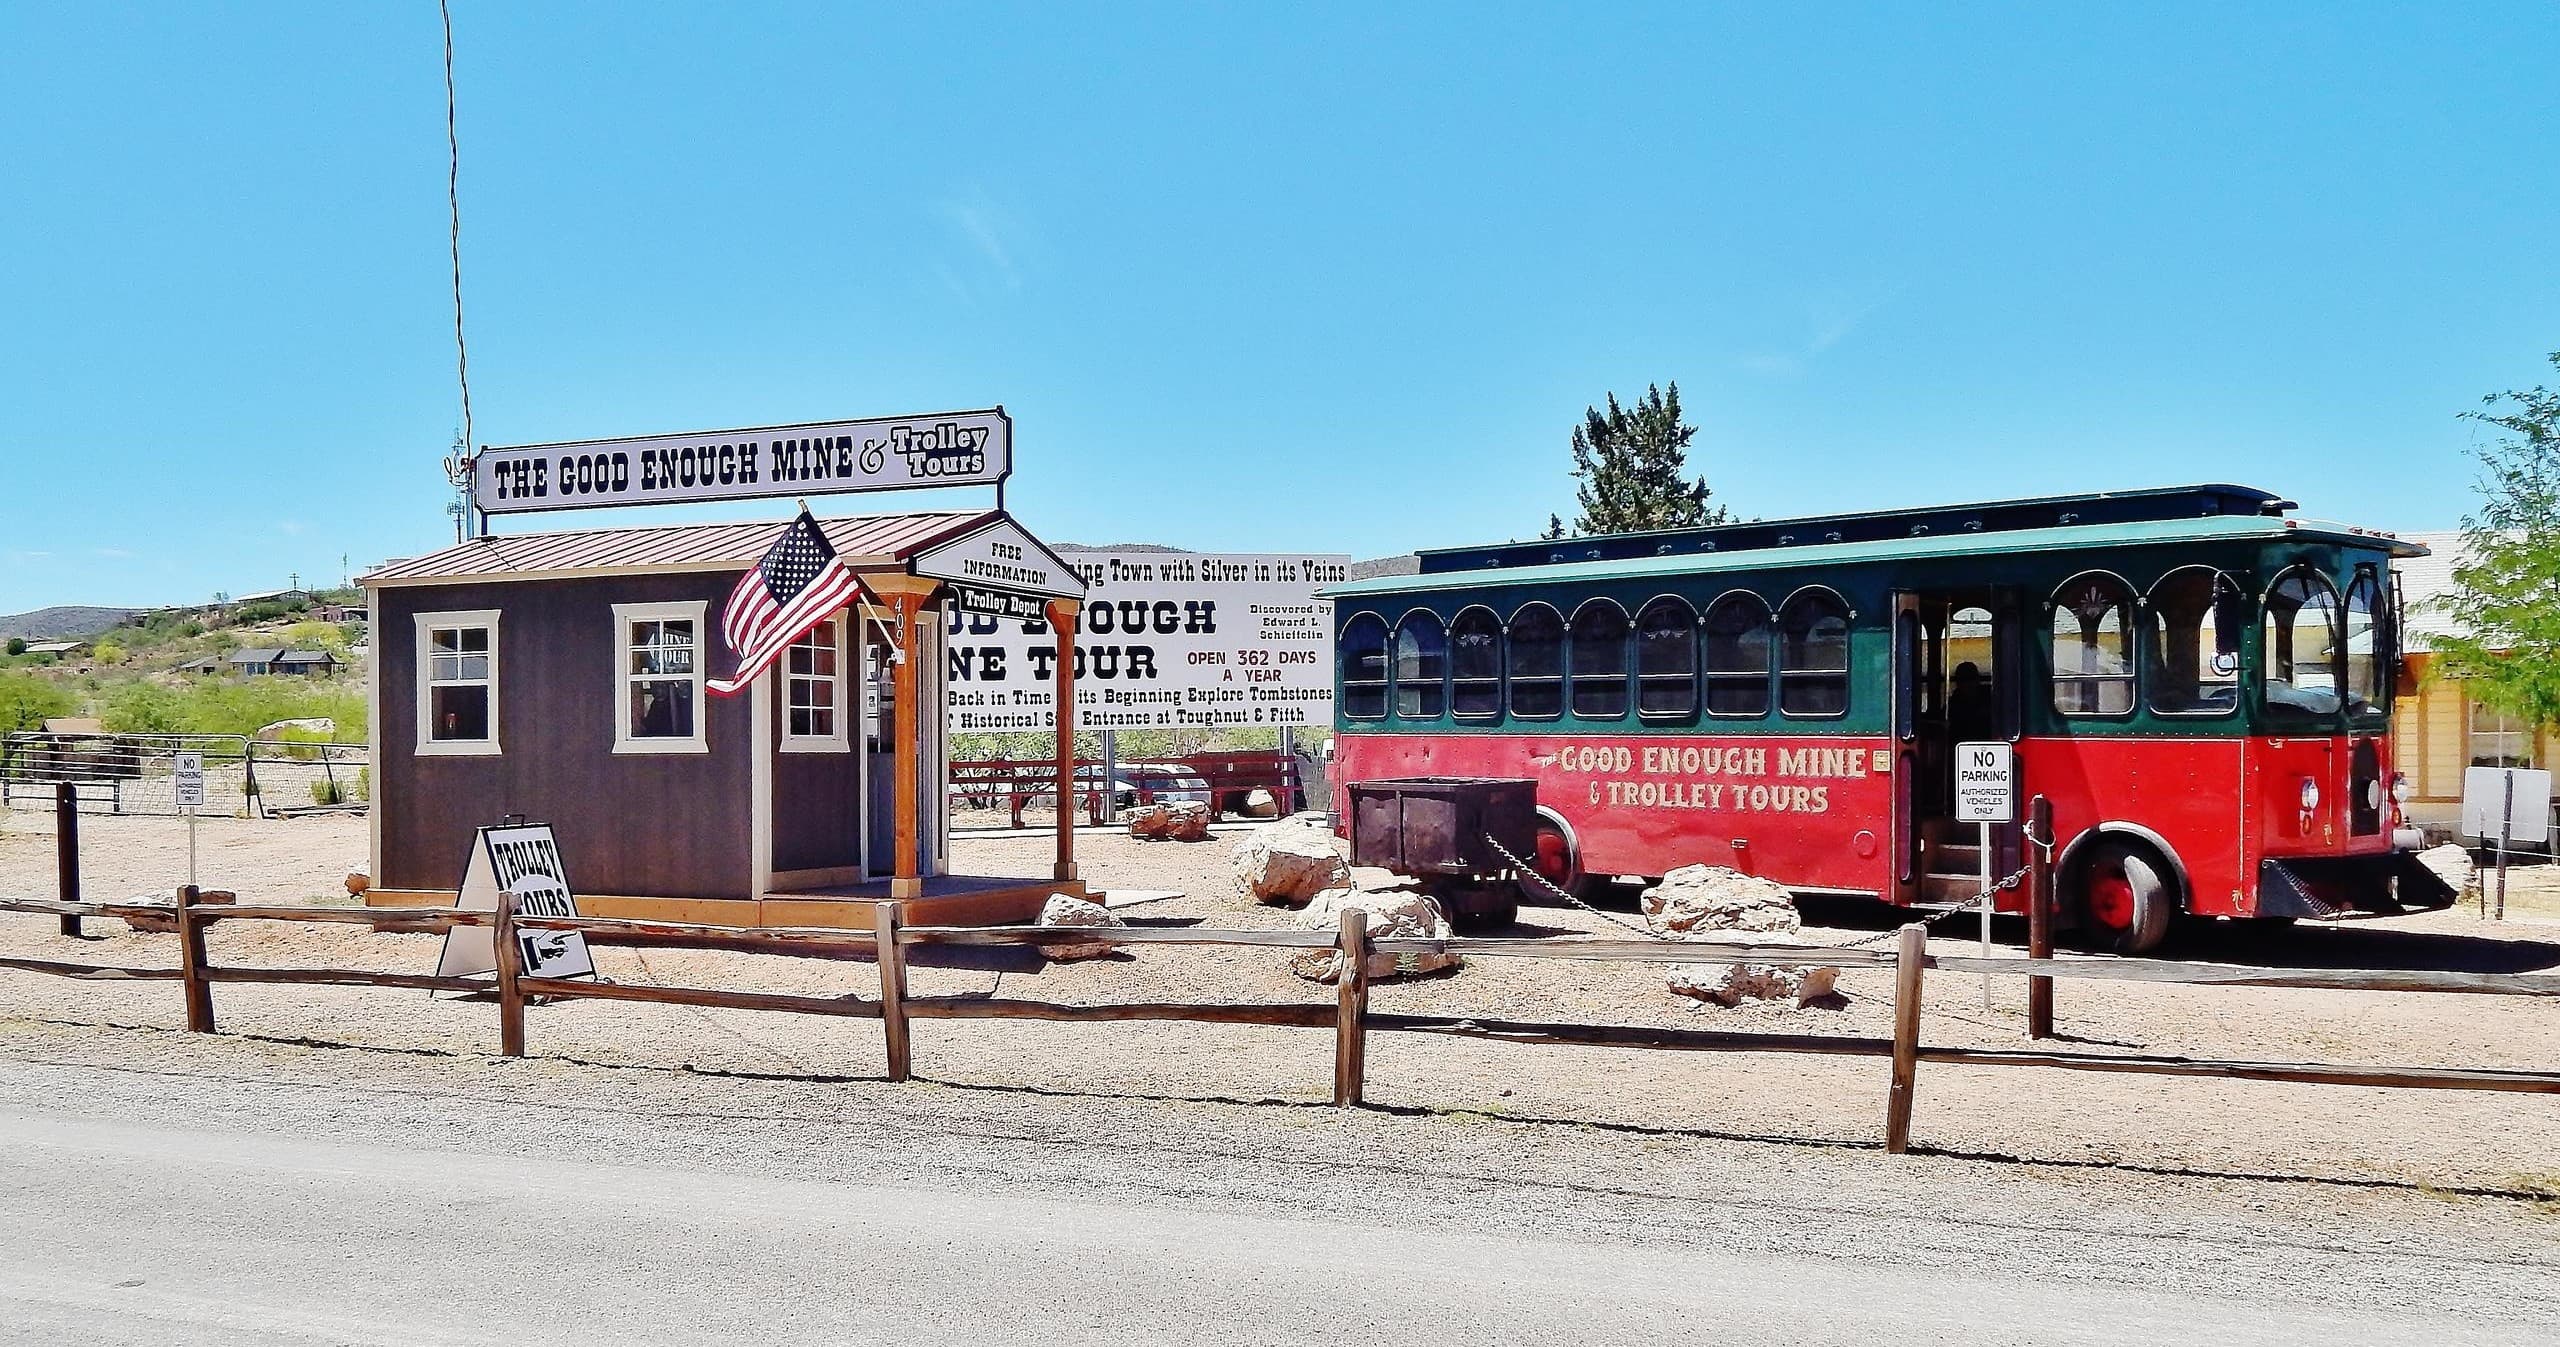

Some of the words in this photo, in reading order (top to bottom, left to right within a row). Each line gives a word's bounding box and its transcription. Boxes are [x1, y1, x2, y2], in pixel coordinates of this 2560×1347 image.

[892, 424, 987, 452] Trolley
[495, 458, 548, 499] THE
[559, 452, 629, 496] GOOD
[641, 443, 758, 491] ENOUGH
[771, 436, 853, 482] MINE
[859, 438, 887, 475] &
[909, 452, 983, 477] Tours
[991, 542, 1022, 561] FREE
[963, 559, 1047, 585] INFORMATION
[1110, 558, 1153, 582] Town
[1160, 558, 1195, 582] with
[1202, 558, 1248, 582] Silver
[1255, 559, 1270, 582] in
[1277, 559, 1296, 582] its
[1303, 559, 1345, 582] Veins
[965, 590, 1006, 614] Trolley
[1010, 596, 1040, 616] Depot
[1249, 604, 1313, 614] Discovered
[1318, 604, 1333, 616] by
[894, 596, 904, 646] 409
[1021, 600, 1217, 635] OUGH
[1262, 617, 1306, 627] Edward
[1311, 617, 1321, 627] L.
[663, 650, 690, 664] OUR
[1187, 651, 1226, 665] OPEN
[1237, 650, 1270, 666] 362
[1278, 650, 1316, 664] DAYS
[1223, 669, 1233, 682] A
[1245, 669, 1282, 682] YEAR
[948, 690, 985, 706] Back
[991, 690, 1006, 705] in
[1013, 689, 1051, 705] Time
[1078, 688, 1097, 704] its
[1104, 687, 1181, 707] Beginning
[1188, 686, 1244, 706] Explore
[1249, 686, 1333, 701] Tombstones
[960, 711, 1038, 728] Historical
[1082, 710, 1151, 726] Entrance
[1156, 710, 1170, 724] at
[1176, 708, 1248, 726] Toughnut
[1254, 708, 1263, 722] &
[1270, 707, 1305, 722] Fifth
[183, 758, 195, 770] NO
[1560, 745, 1633, 773] GOOD
[1642, 747, 1767, 776] ENOUGH
[1778, 747, 1867, 778] MINE
[1974, 751, 1995, 767] NO
[1961, 770, 2008, 782] PARKING
[1589, 780, 1600, 805] &
[1607, 781, 1724, 809] TROLLEY
[1732, 784, 1830, 813] TOURS
[1960, 788, 2008, 796] AUTHORIZED
[1966, 797, 2003, 805] VEHICLES
[1974, 807, 1994, 815] ONLY
[494, 839, 562, 891] TROLLEY
[515, 887, 570, 917] OURS
